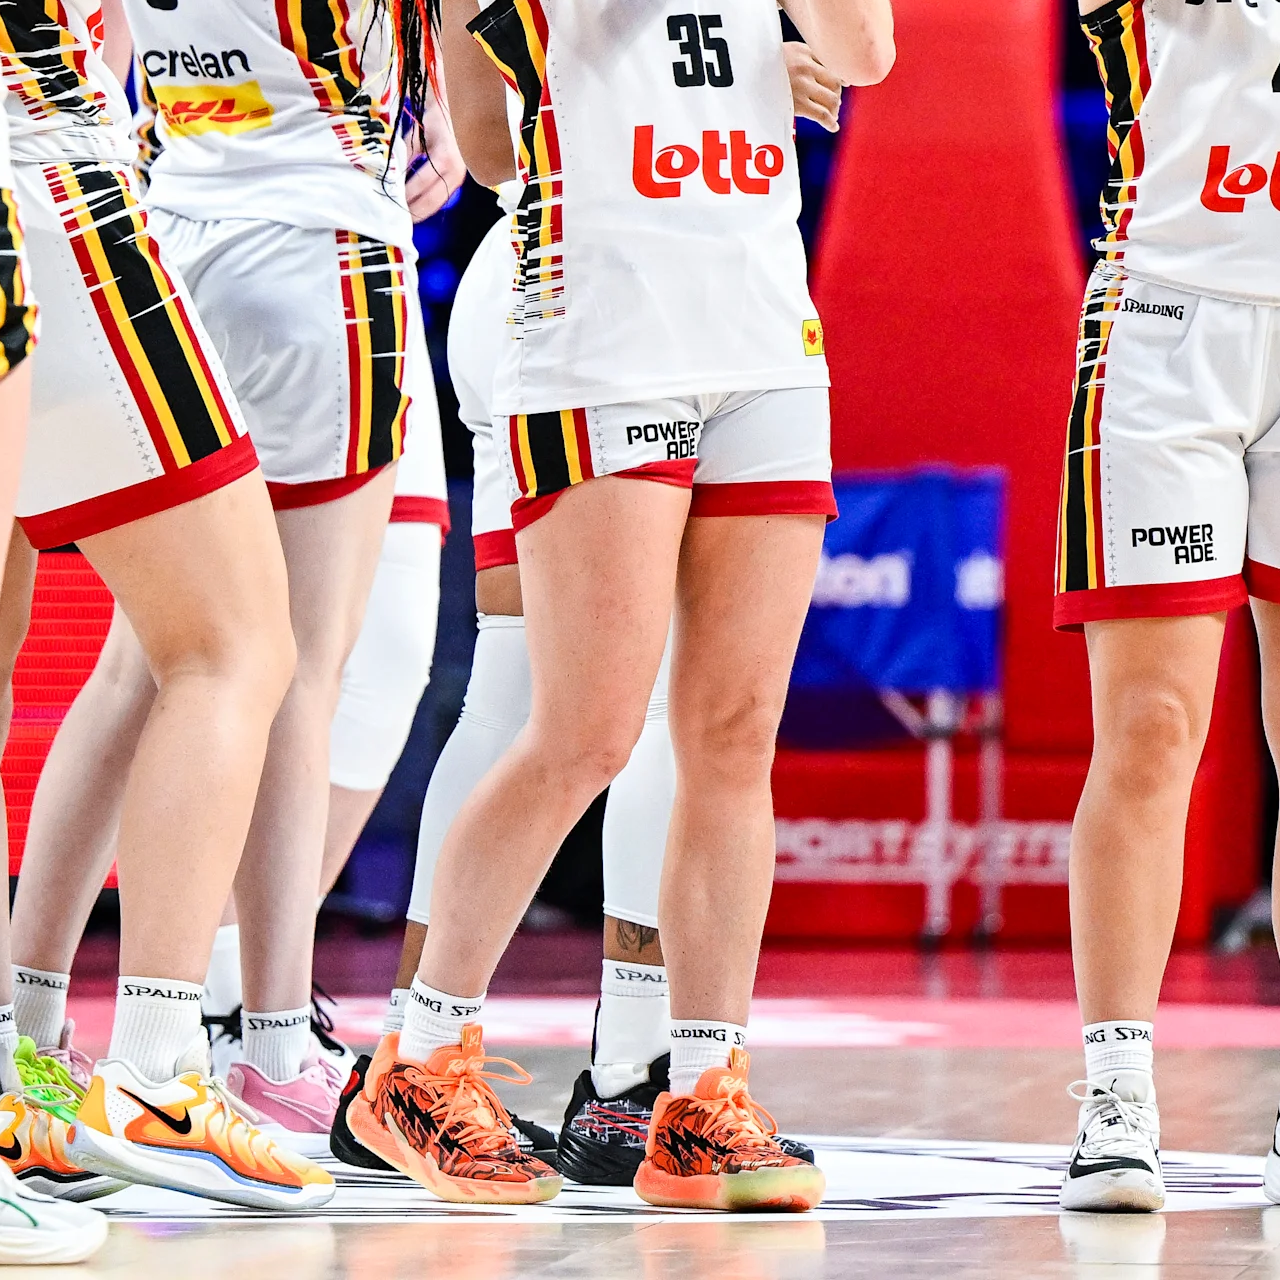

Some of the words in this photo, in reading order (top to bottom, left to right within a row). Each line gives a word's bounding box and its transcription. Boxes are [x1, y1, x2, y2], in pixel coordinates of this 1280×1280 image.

[143, 44, 252, 79] crelan
[666, 13, 735, 88] 35
[1121, 298, 1184, 321] SPALDING
[626, 420, 700, 445] POWER
[1131, 523, 1213, 548] POWER
